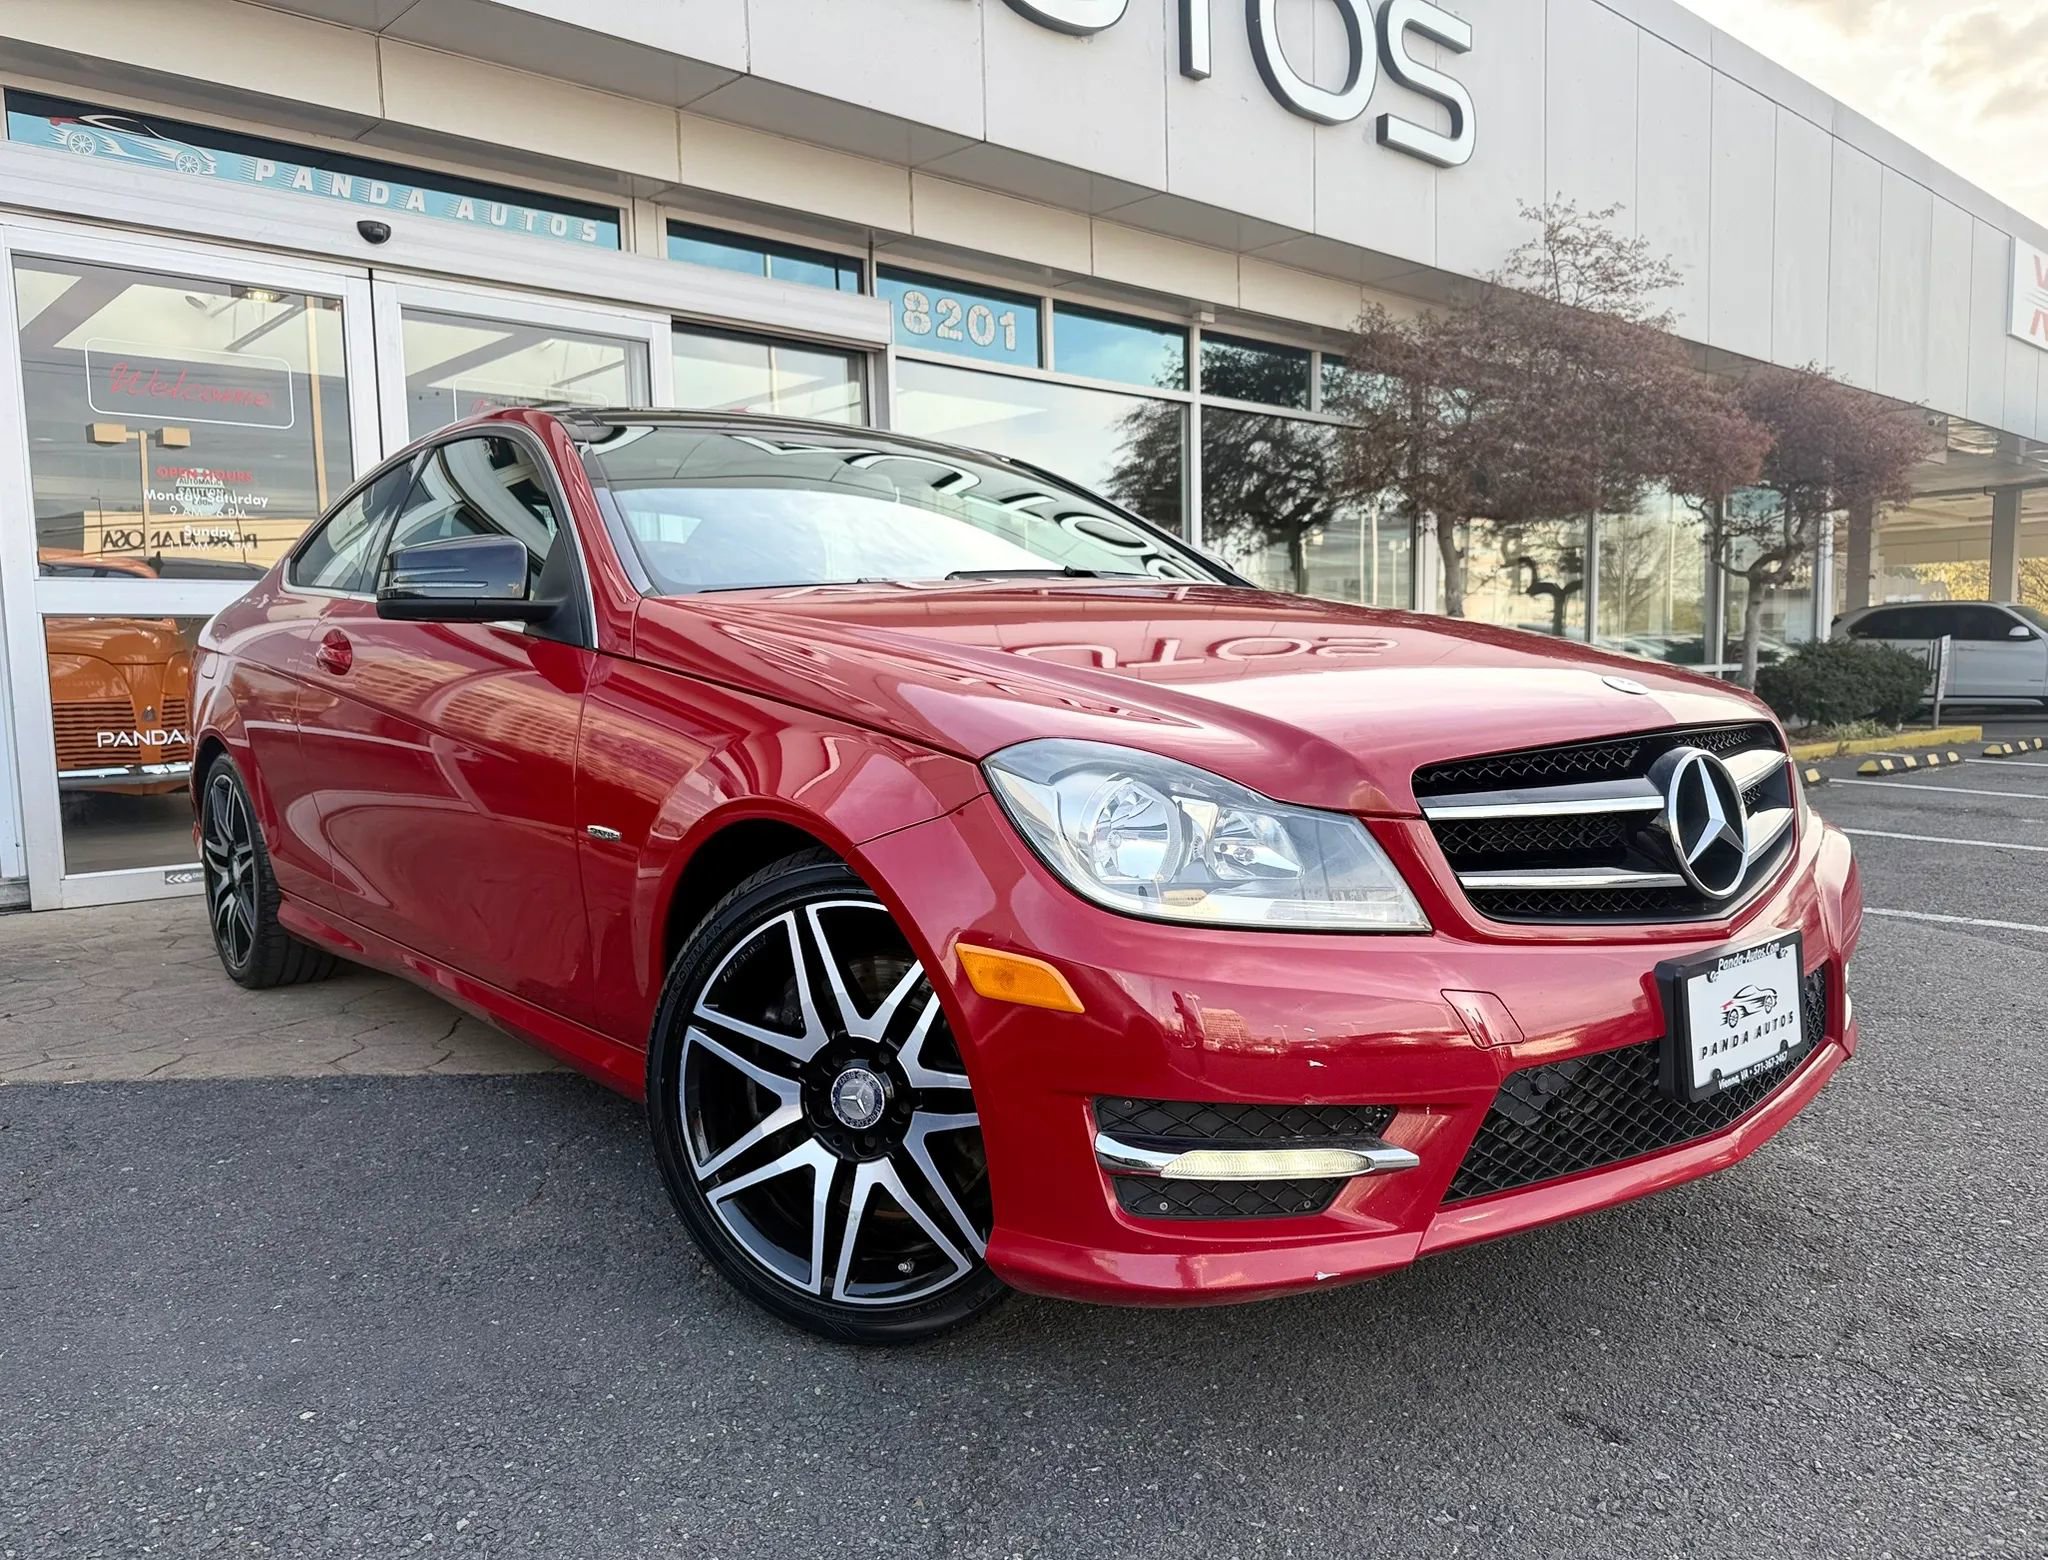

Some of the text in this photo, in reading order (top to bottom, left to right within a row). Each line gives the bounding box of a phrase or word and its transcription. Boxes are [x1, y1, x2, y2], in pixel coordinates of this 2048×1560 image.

[254, 157, 597, 242] PANDA AUTOS
[903, 290, 1017, 351] 8201
[182, 508, 203, 517] AM
[228, 508, 247, 518] PM
[184, 525, 236, 540] Sunday
[188, 541, 210, 551] AM
[97, 729, 186, 748] PANDA
[1701, 1010, 1794, 1060] PANDA AUTOS
